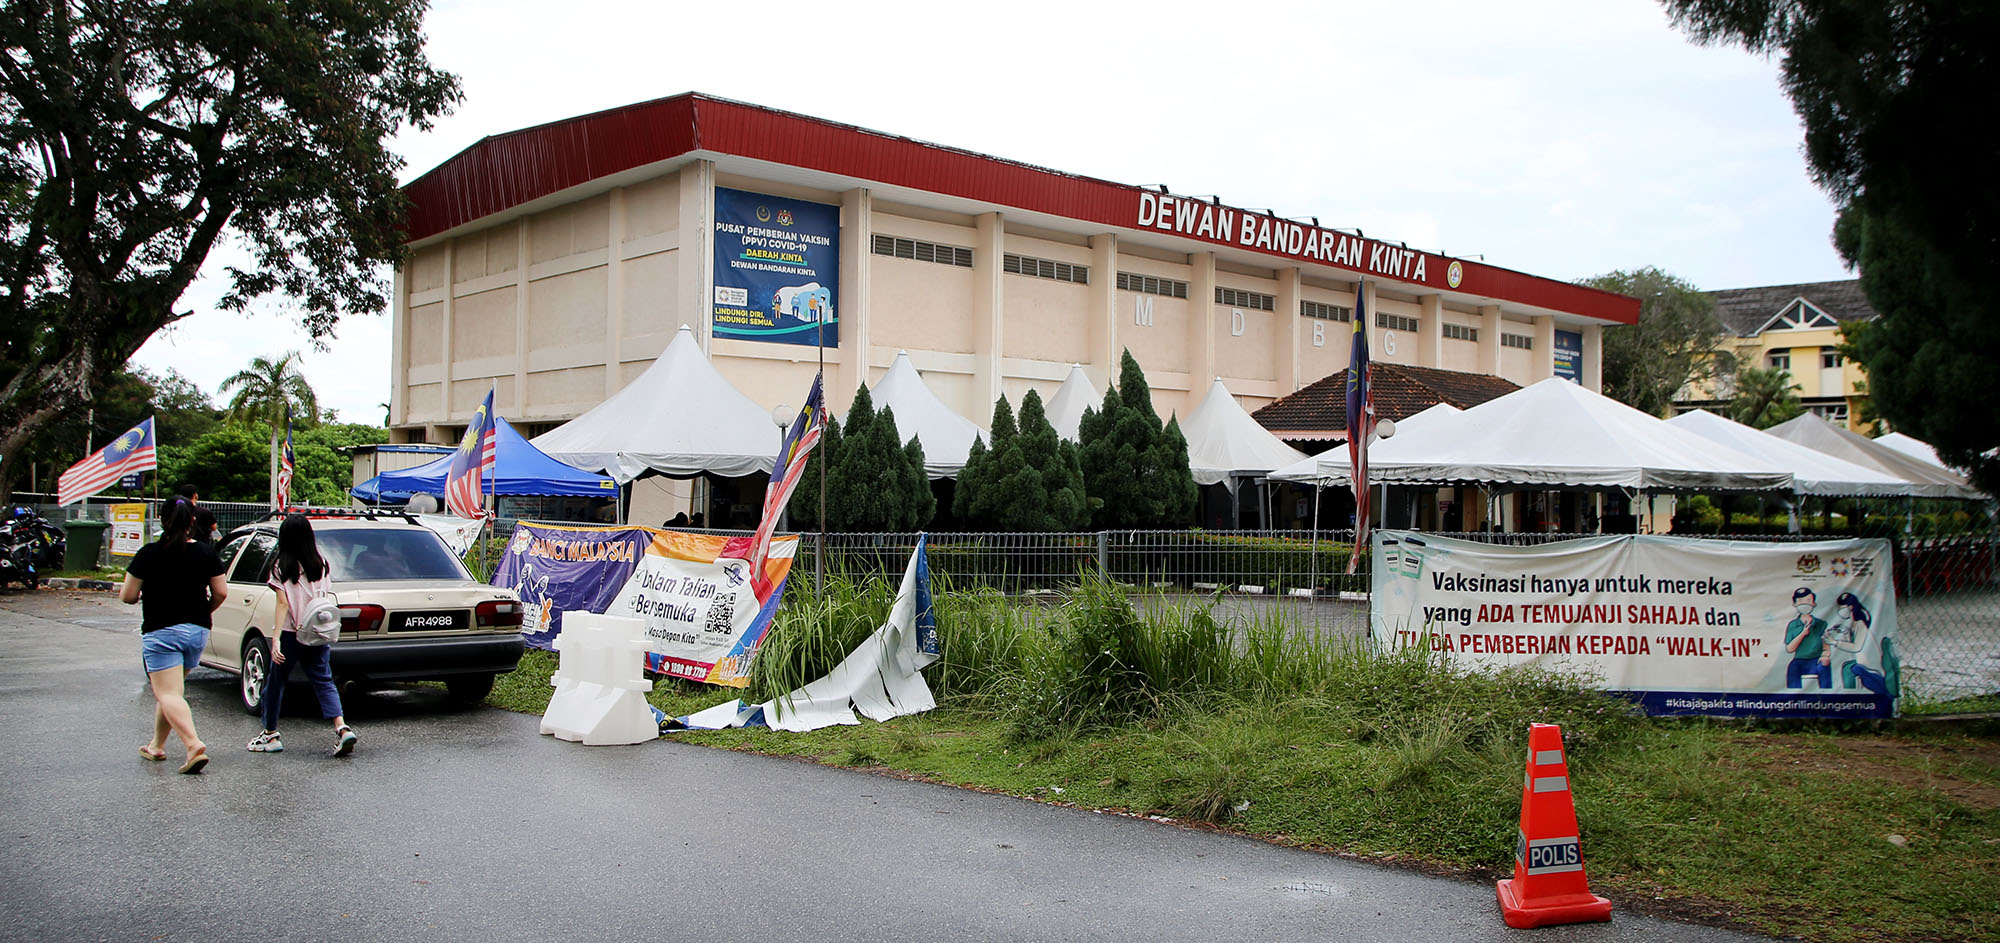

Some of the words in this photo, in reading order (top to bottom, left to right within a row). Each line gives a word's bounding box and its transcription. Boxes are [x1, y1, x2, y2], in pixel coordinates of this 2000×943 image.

[716, 222, 745, 234] PUSAT
[747, 227, 798, 241] PEMBERIAN
[799, 234, 830, 246] VAKSIN
[741, 234, 767, 249] (PPV)
[768, 238, 808, 252] COVID-19
[1138, 193, 1234, 241] DEWAN
[1239, 214, 1364, 268] BANDARAN
[1369, 243, 1427, 282] KINTA
[746, 248, 779, 260] DAERAH
[781, 253, 804, 263] KINTA
[731, 260, 758, 270] DEWAN
[758, 262, 796, 274] BANDARAN
[797, 268, 816, 277] KINTA
[715, 307, 748, 317] LINDUNGI
[715, 315, 748, 325] LINDUNGI
[750, 318, 775, 327] SEMUA.
[1135, 295, 1153, 327] M
[1231, 307, 1246, 337] D
[1312, 320, 1325, 347] B
[1383, 330, 1397, 356] G
[529, 538, 568, 561] BANCI
[568, 540, 635, 563] MALAYSIA
[680, 577, 717, 599] Talian
[1432, 571, 1526, 593] Vaksinasi
[1531, 574, 1589, 597] hanya
[1595, 575, 1650, 594] untuk
[1657, 577, 1733, 596] mereka
[636, 594, 697, 623] Bersemuka
[1423, 604, 1472, 627] yang
[1477, 603, 1515, 623] ADA
[1521, 603, 1624, 625] TEMUJANJI
[1627, 604, 1700, 626] SAHAJA
[1704, 606, 1741, 628] dan
[662, 629, 681, 643] Depan
[1398, 630, 1455, 652] TIDA
[1460, 633, 1570, 655] PEMBERIAN
[1576, 634, 1651, 656] KEPADA
[1666, 698, 1733, 710] #kitajagakita
[1735, 699, 1876, 711] #lindungdirilindungsemua
[1531, 844, 1578, 867] POLIS
